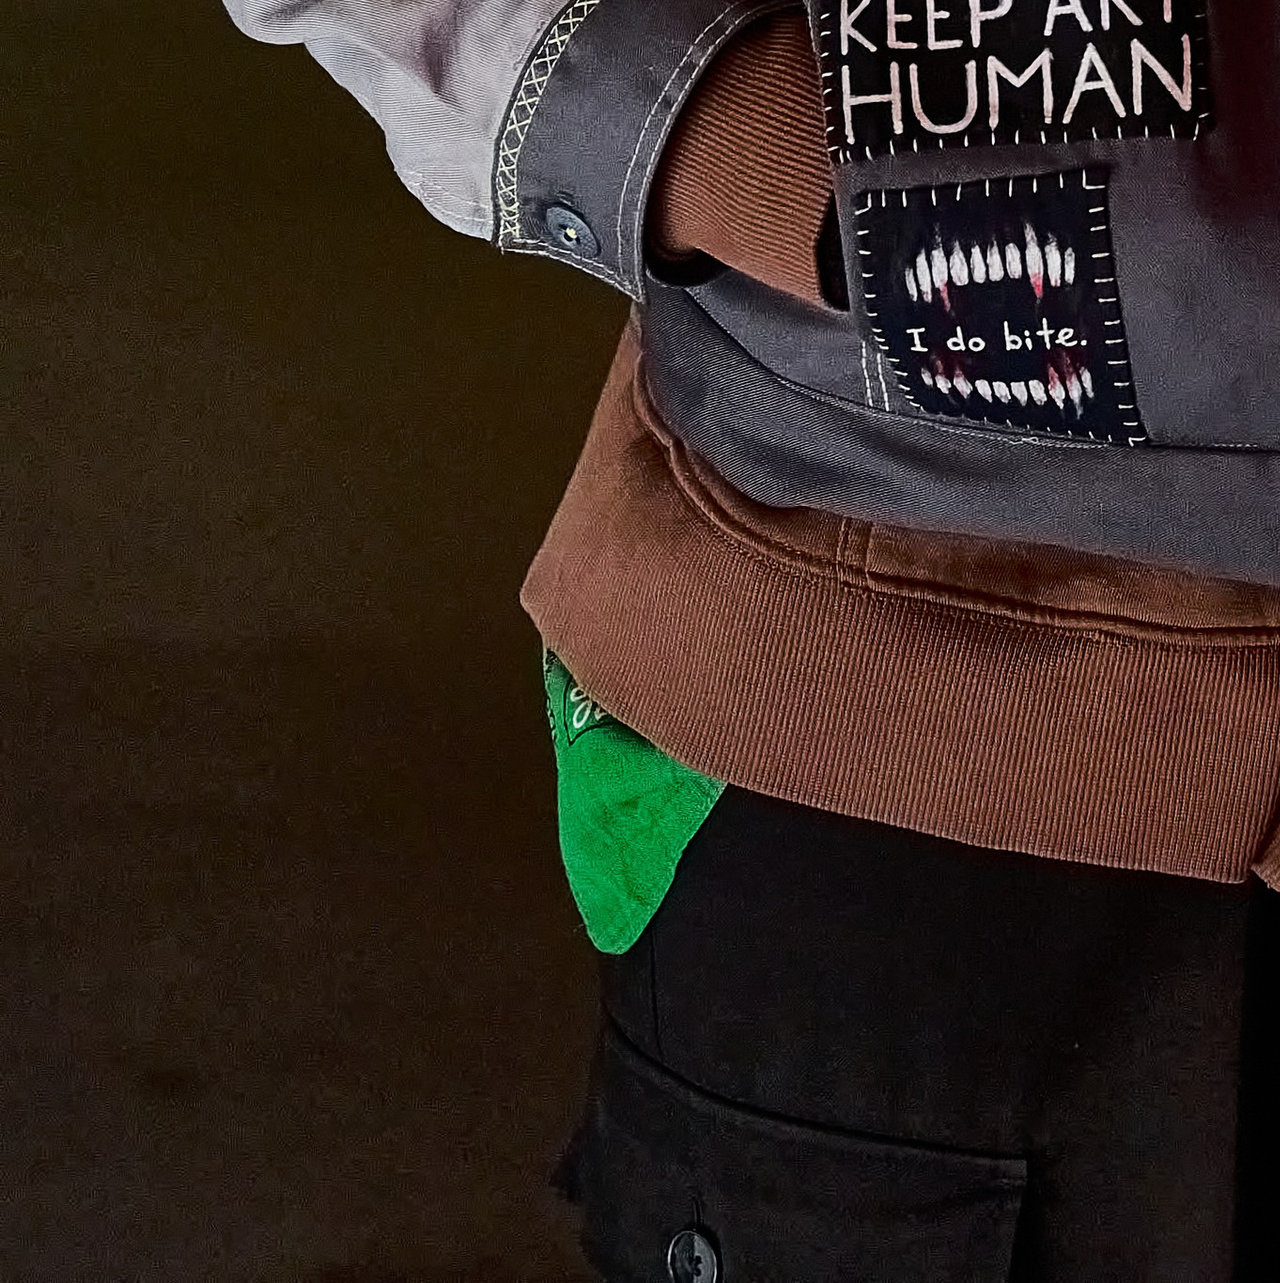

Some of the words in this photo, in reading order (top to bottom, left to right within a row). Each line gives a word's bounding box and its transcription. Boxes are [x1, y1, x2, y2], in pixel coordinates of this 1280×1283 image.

[840, 33, 1193, 145] HUMAN
[905, 327, 929, 352] I
[946, 325, 986, 352] do
[1003, 317, 1088, 352] bite.
